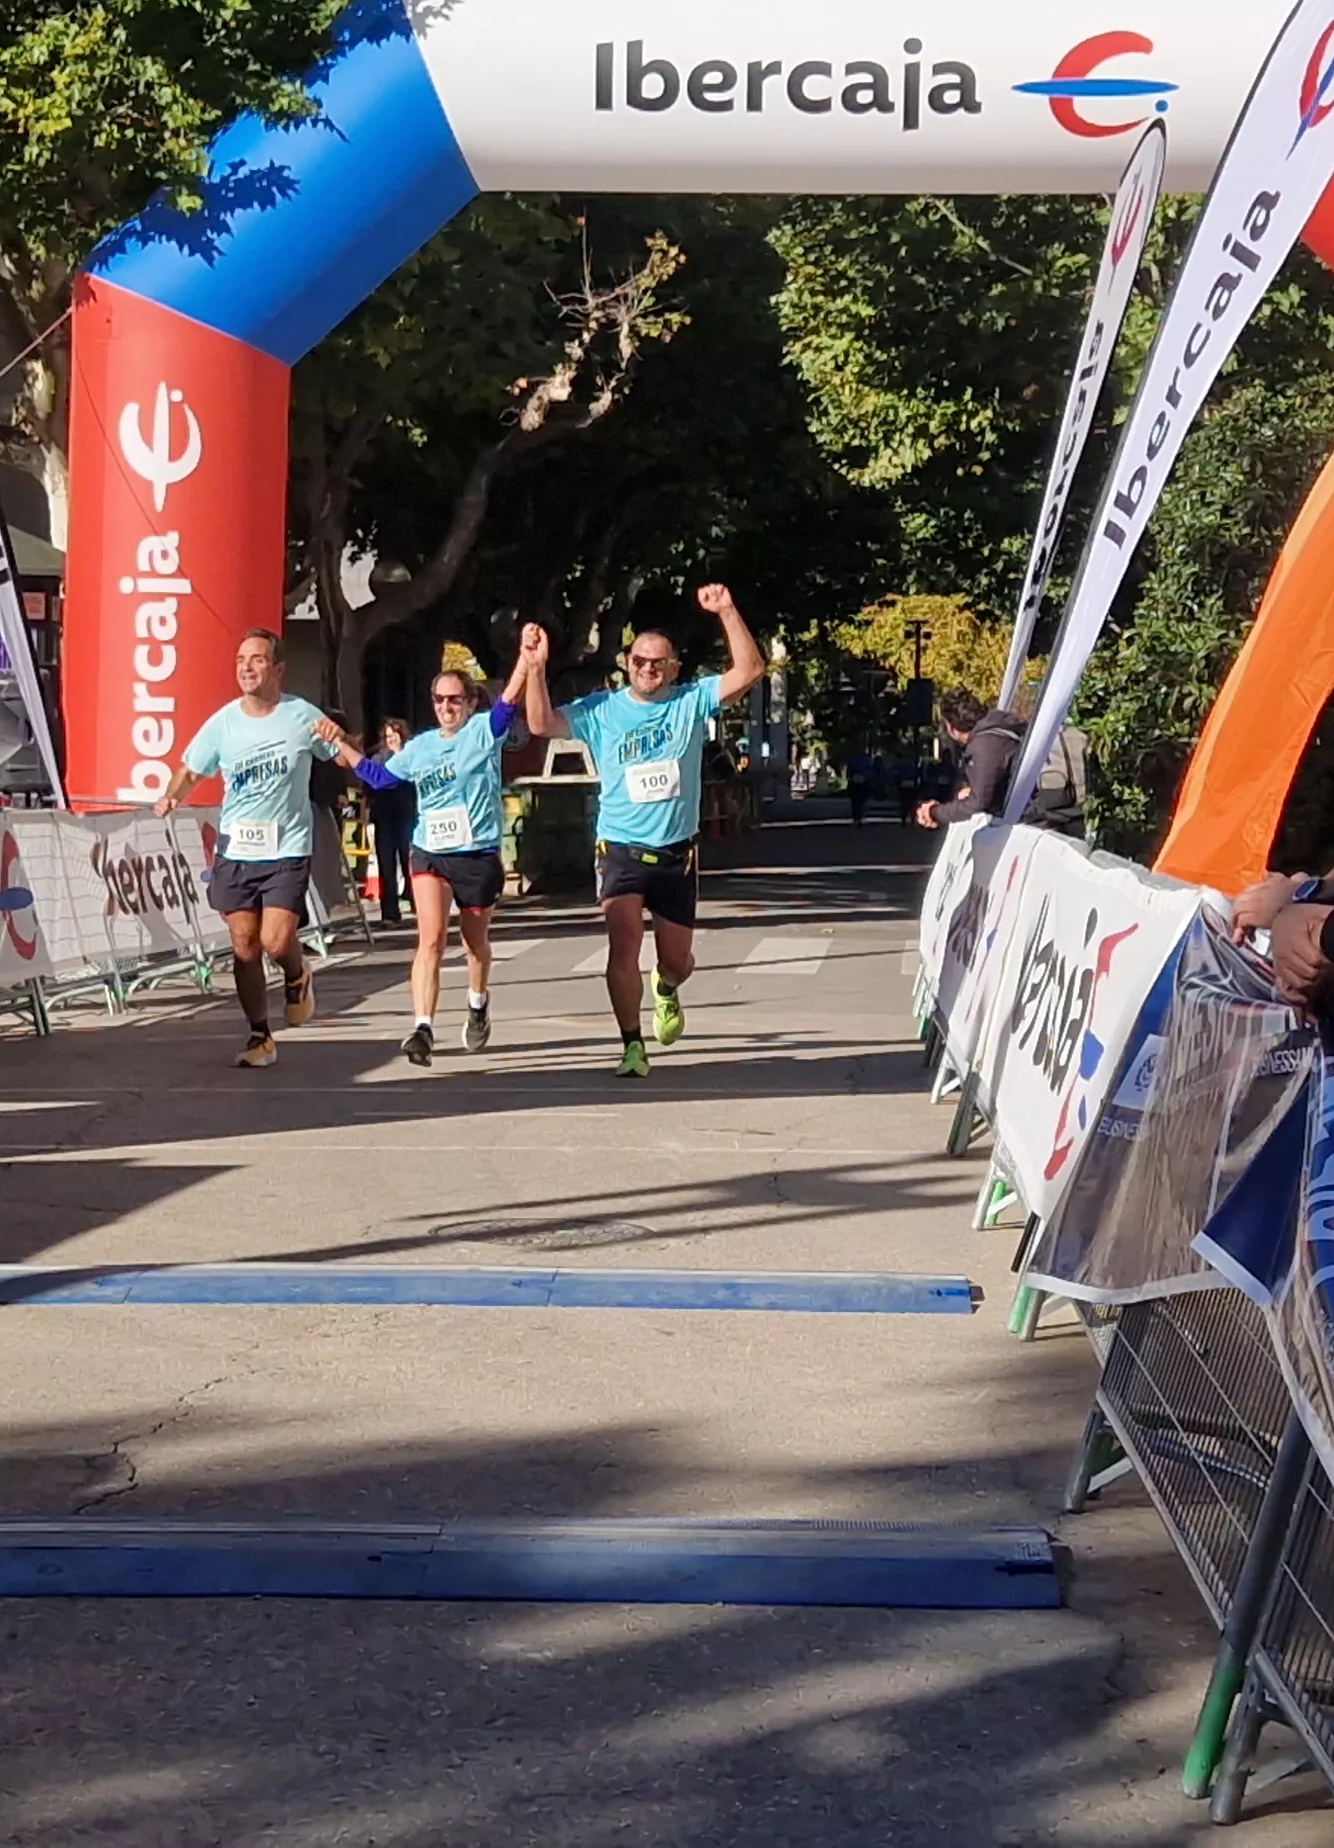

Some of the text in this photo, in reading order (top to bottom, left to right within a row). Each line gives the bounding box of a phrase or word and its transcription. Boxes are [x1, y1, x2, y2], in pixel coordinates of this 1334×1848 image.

[595, 37, 983, 132] Ibercaja
[1103, 189, 1281, 551] Ibercaja
[116, 530, 192, 803] bercaja
[640, 774, 669, 788] 100
[238, 828, 265, 842] 105
[430, 821, 458, 835] 250
